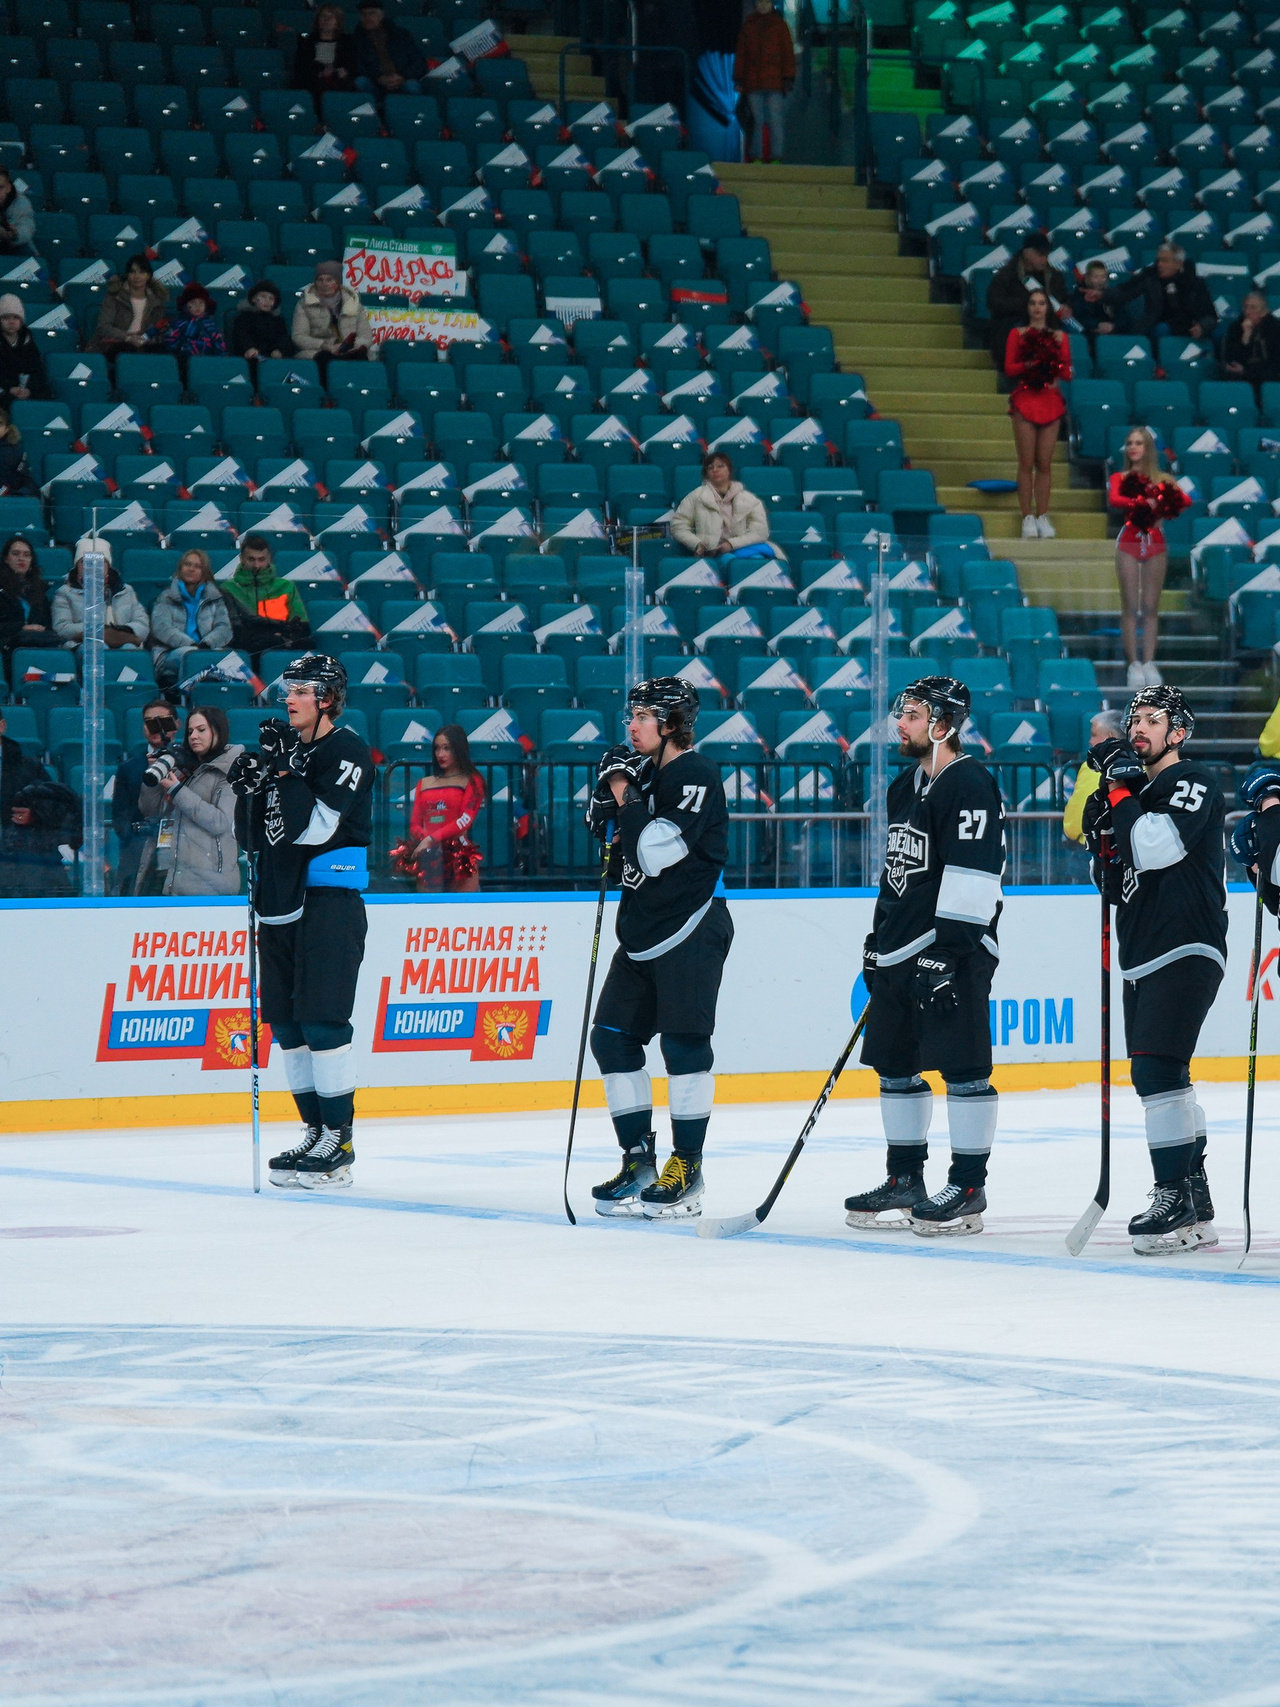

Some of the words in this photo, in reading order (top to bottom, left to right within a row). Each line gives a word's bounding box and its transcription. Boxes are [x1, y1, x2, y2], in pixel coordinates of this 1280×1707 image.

[335, 759, 362, 792] 79
[677, 785, 707, 814] 71
[1169, 780, 1208, 812] 25
[958, 809, 987, 840] 27
[131, 930, 248, 958] КРАСНАЯ
[405, 926, 514, 952] КРАСНАЯ
[126, 962, 260, 1001] МАШИН
[400, 956, 540, 994] МАШИНА
[119, 1016, 195, 1042] ЮНИОР
[394, 1010, 464, 1034] ЮНИОР
[801, 1074, 837, 1144] CCM
